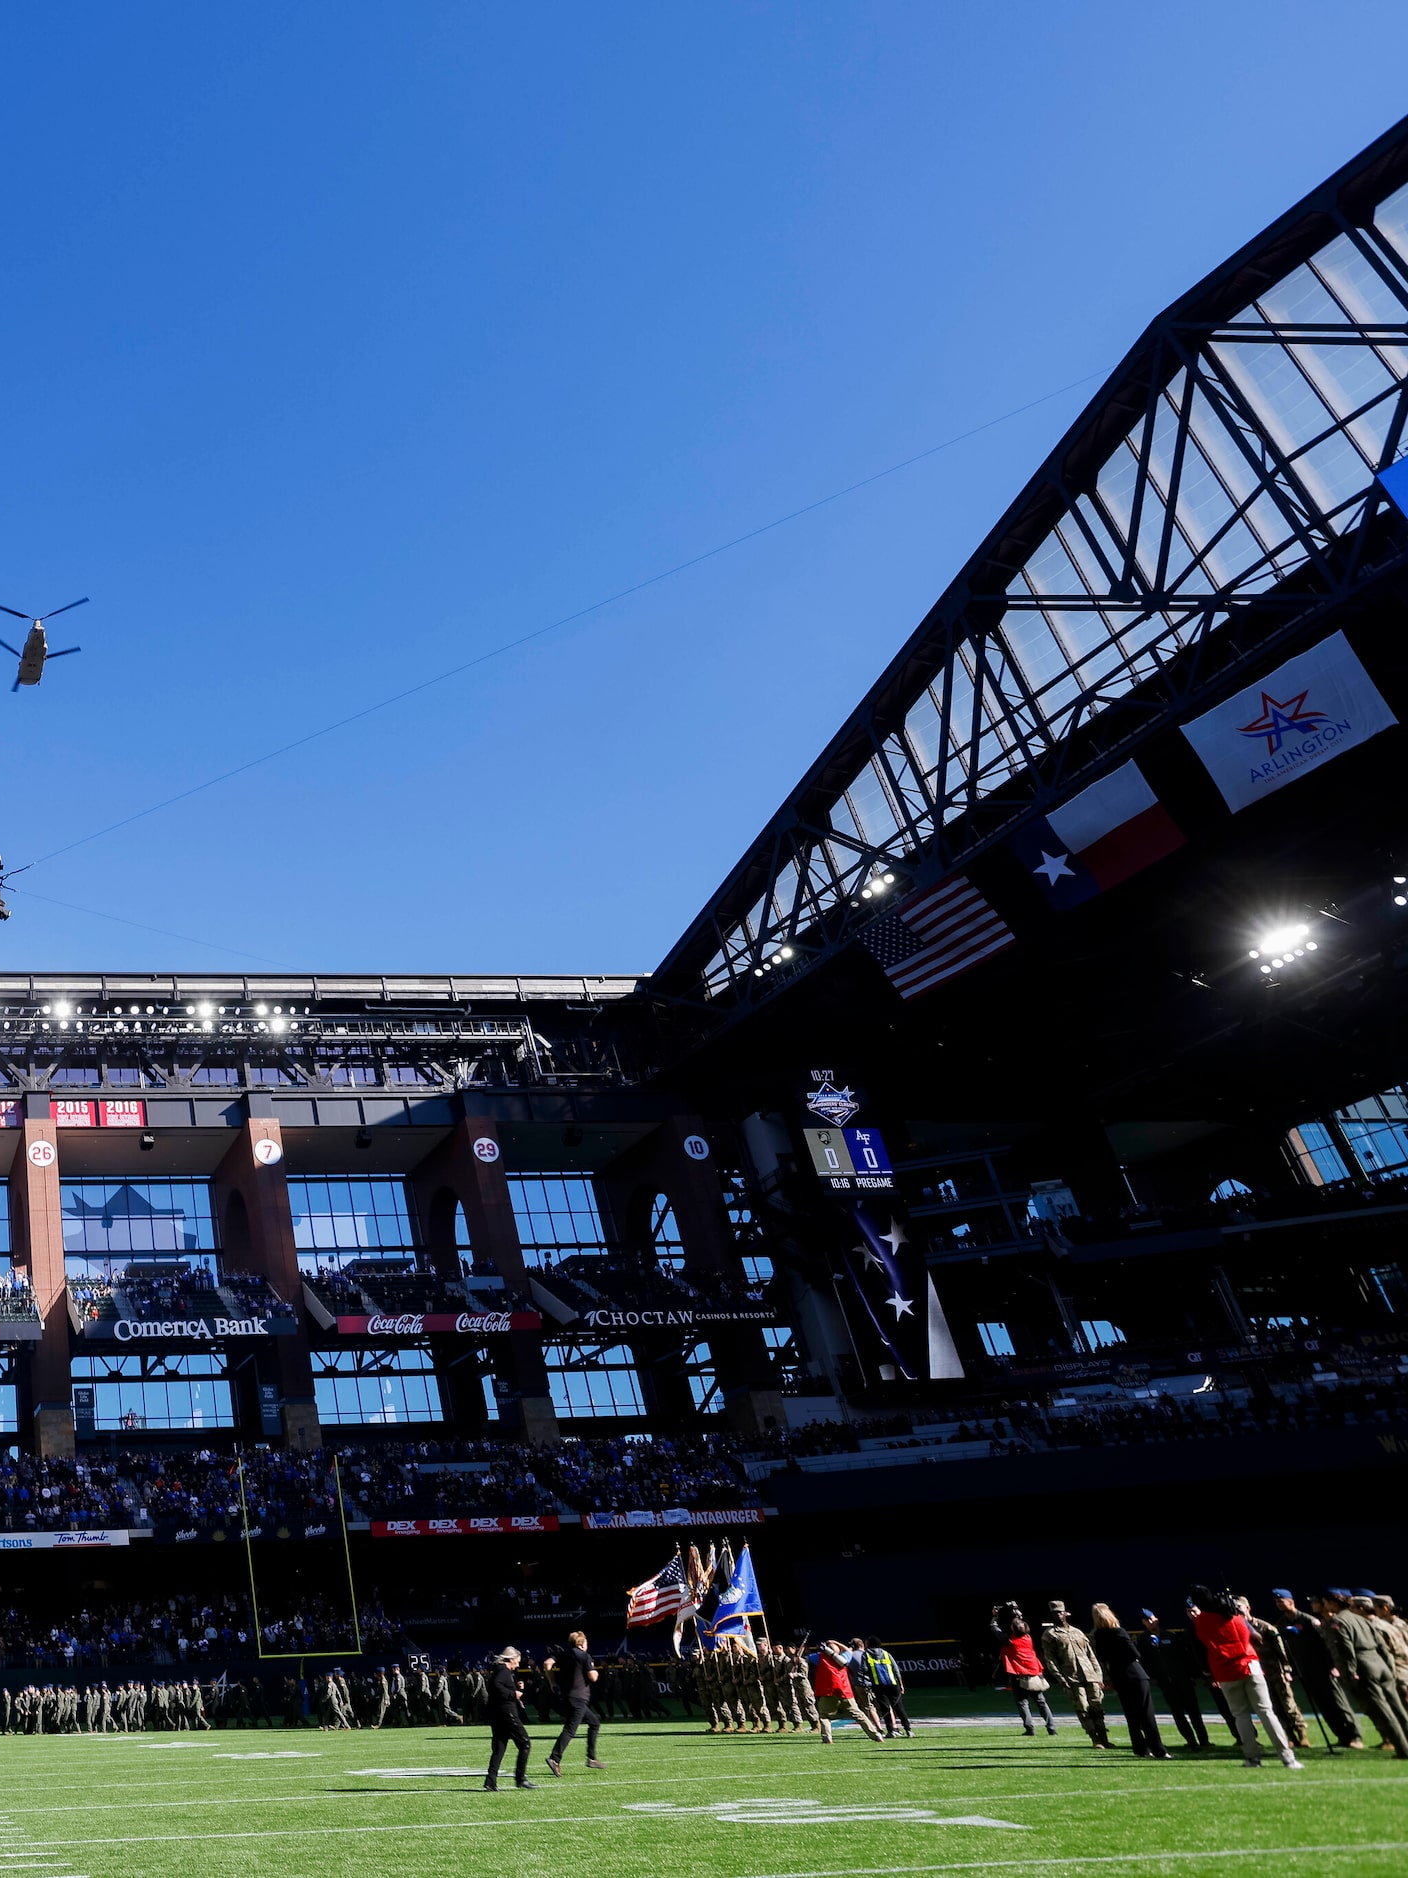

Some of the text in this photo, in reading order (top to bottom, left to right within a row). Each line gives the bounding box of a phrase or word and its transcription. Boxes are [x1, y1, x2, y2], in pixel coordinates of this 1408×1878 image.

[1250, 719, 1352, 783] ARLINGTON
[810, 1069, 835, 1082] 10:27
[57, 1100, 88, 1114] 2015
[106, 1100, 138, 1114] 2016
[32, 1146, 52, 1160] 26
[264, 1145, 272, 1160] 7
[475, 1143, 497, 1157] 29
[688, 1141, 706, 1155] 10
[824, 1147, 879, 1168] 0 0
[855, 1177, 894, 1188] PREGAME
[367, 1313, 425, 1335] Coca-Cola
[455, 1312, 512, 1333] Coca-Cola
[595, 1309, 693, 1326] CHOCTAW
[696, 1312, 731, 1320] CASINOS
[740, 1311, 776, 1319] RESORTS
[214, 1316, 269, 1335] Bank
[1187, 1352, 1203, 1362] QT
[1304, 1340, 1320, 1351] QT
[1053, 1359, 1111, 1372] DISPLAYS
[429, 1519, 458, 1529] DEX
[470, 1518, 499, 1528] DEX
[511, 1516, 540, 1526] DEX
[682, 1509, 759, 1525] HATABURGER
[387, 1520, 416, 1531] DEX
[54, 1531, 109, 1544] Tom Thumb
